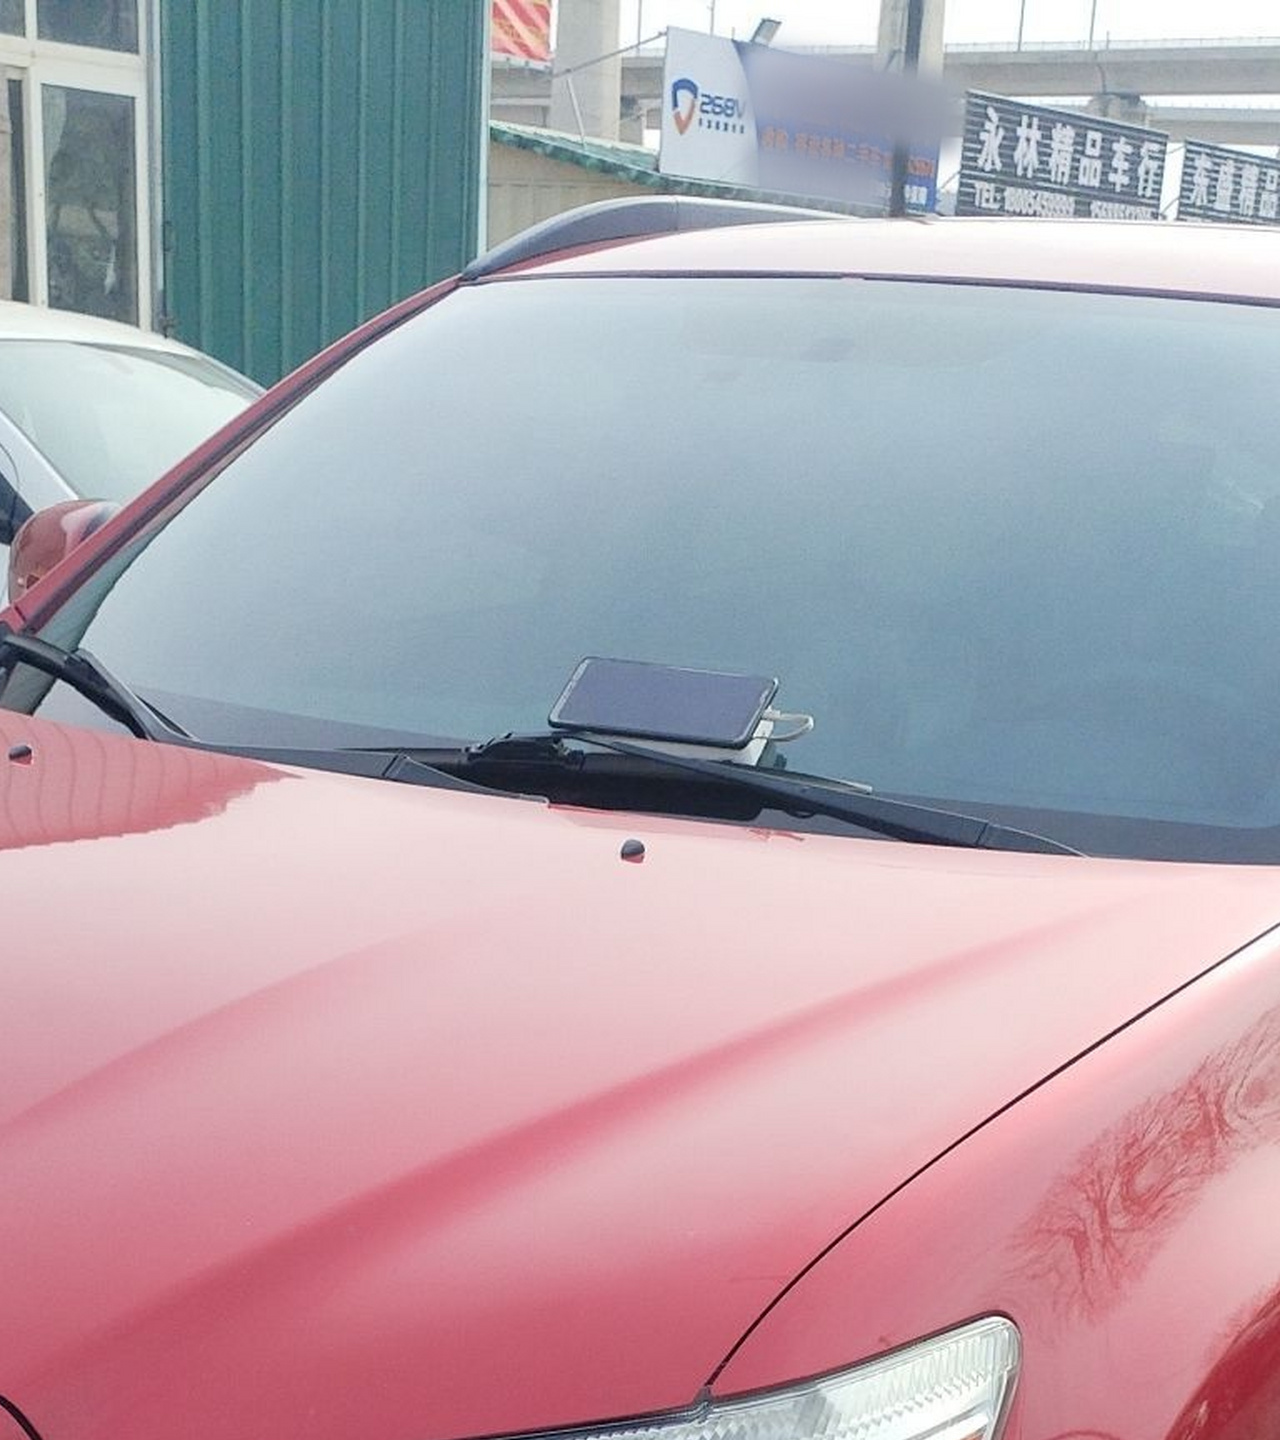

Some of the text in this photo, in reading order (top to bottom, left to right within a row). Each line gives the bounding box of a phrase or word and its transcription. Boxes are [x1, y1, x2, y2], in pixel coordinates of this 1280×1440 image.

[976, 105, 1162, 198] 永林精品车行
